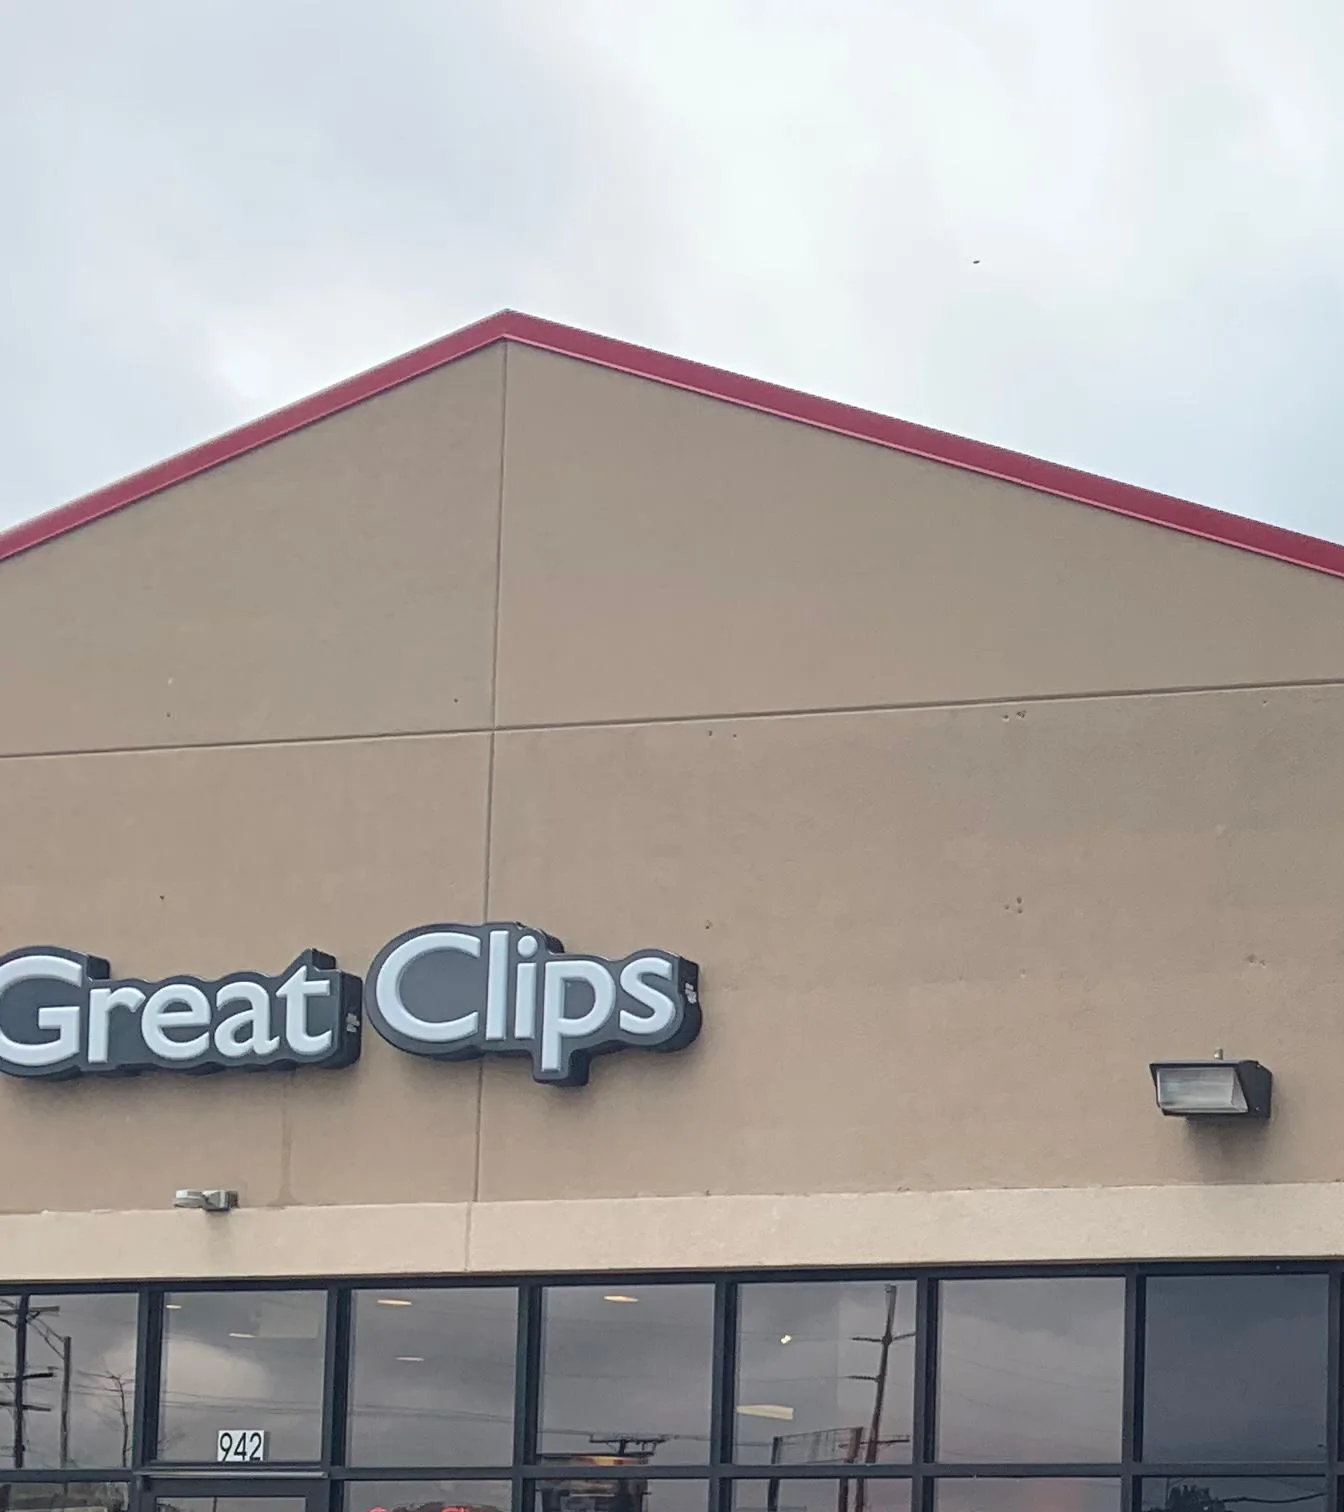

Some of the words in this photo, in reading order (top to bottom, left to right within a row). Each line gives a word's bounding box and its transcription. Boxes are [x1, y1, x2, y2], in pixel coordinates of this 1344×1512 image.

[0, 955, 333, 1066] Great
[376, 930, 679, 1072] Clips
[220, 1431, 262, 1462] 942
